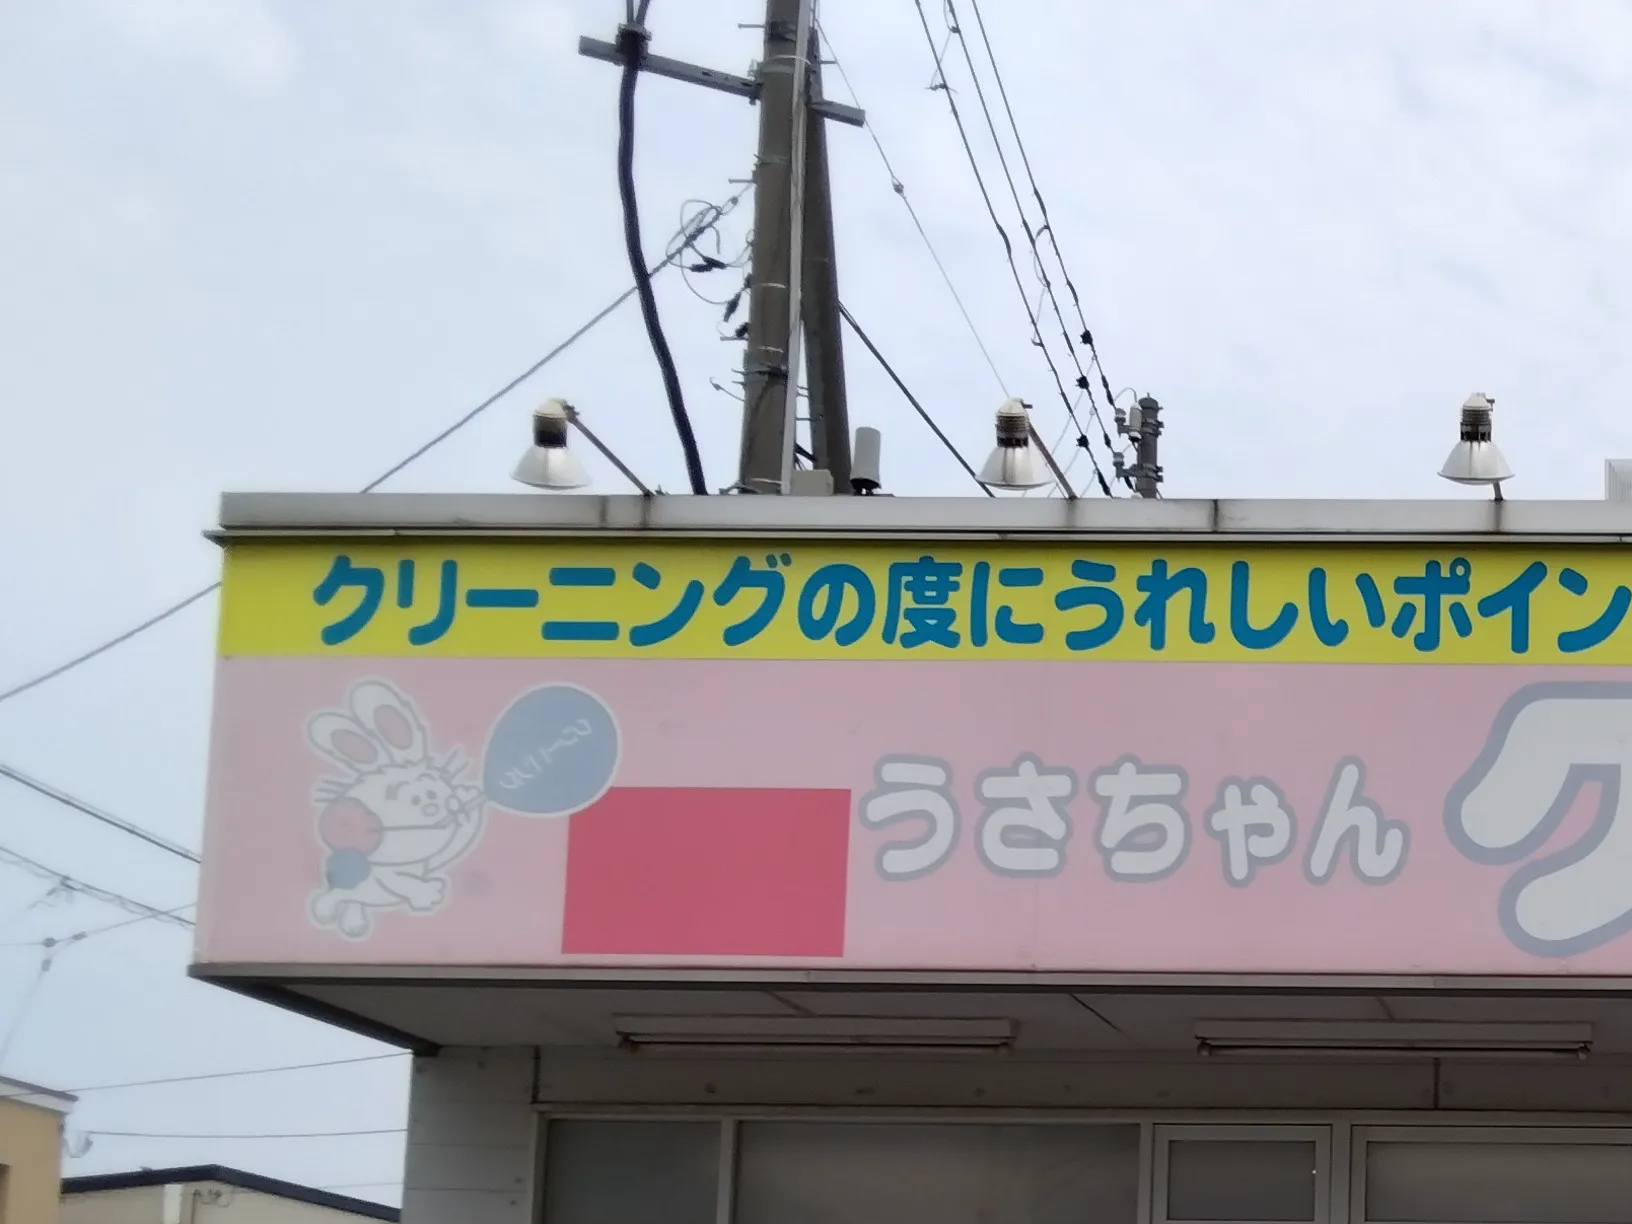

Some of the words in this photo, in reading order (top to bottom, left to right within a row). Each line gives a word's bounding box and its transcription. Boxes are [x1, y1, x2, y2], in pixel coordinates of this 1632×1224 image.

[862, 752, 1408, 885] うさちゃん
